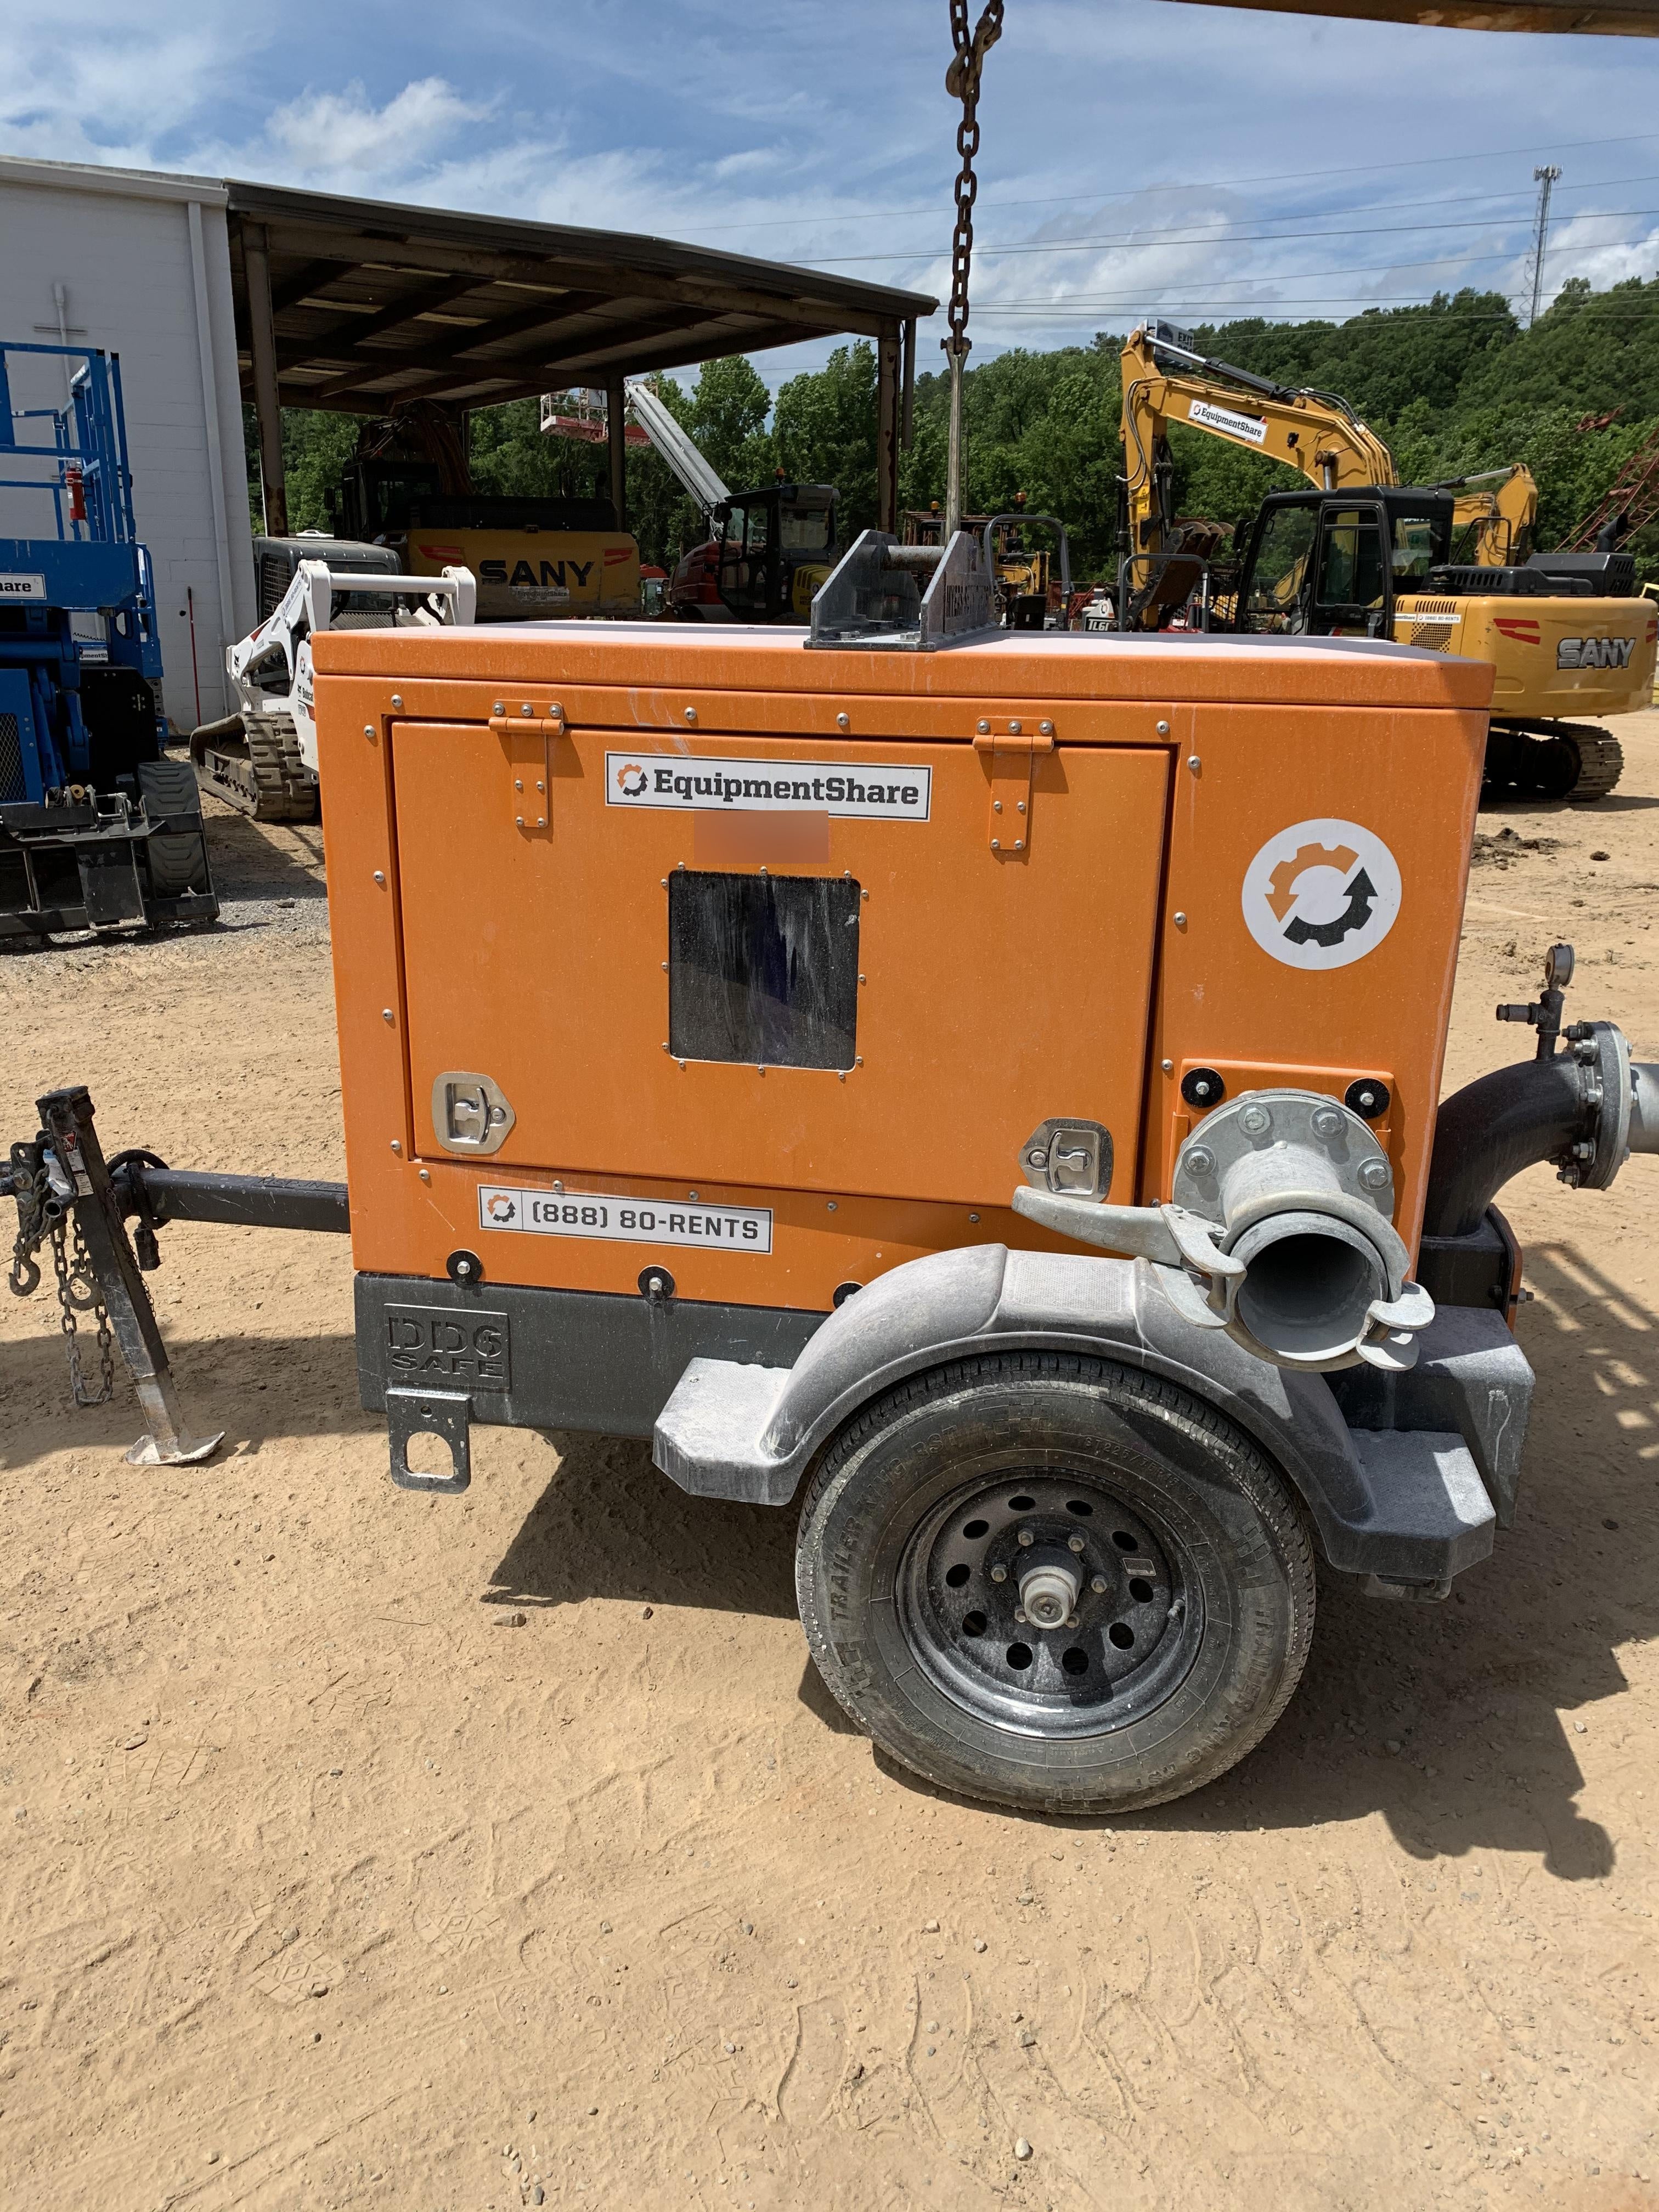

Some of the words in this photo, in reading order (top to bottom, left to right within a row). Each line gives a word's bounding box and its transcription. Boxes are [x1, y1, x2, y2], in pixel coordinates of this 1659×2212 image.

[1178, 331, 1193, 346] EXIT
[1201, 407, 1262, 437] EquipmentShare
[479, 560, 595, 586] SANY
[1557, 637, 1637, 670] SANY
[654, 769, 919, 805] EquipmentShare
[533, 1201, 608, 1228] (888)
[620, 1210, 758, 1240] 80-RENTS
[391, 1353, 504, 1378] SAFE
[830, 1515, 863, 1621] TRAILER
[855, 1458, 908, 1514] KING
[1233, 1610, 1274, 1712] TRAILER
